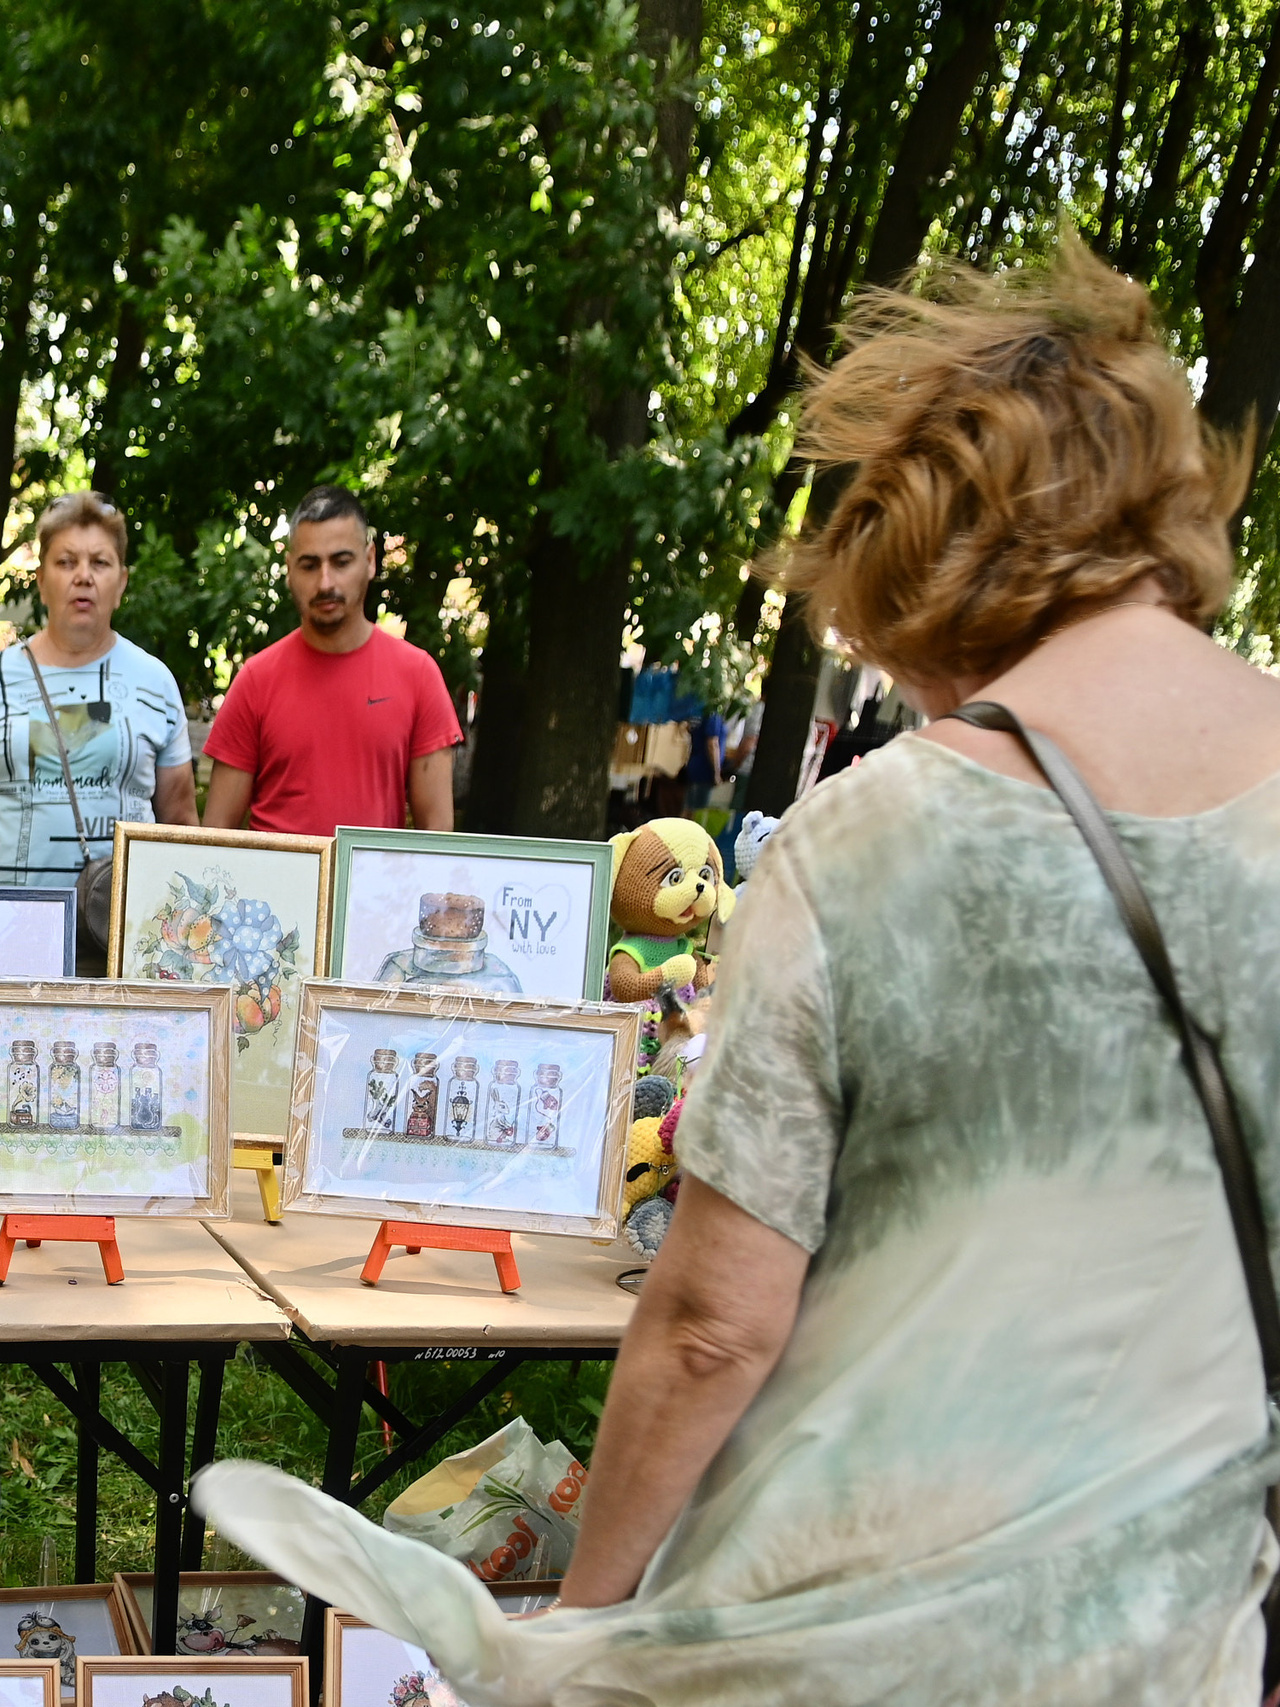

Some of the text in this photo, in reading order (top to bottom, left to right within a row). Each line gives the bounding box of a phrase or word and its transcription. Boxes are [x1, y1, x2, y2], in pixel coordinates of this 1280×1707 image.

[502, 887, 532, 907] From
[509, 909, 557, 942] NY
[512, 941, 557, 955] with love
